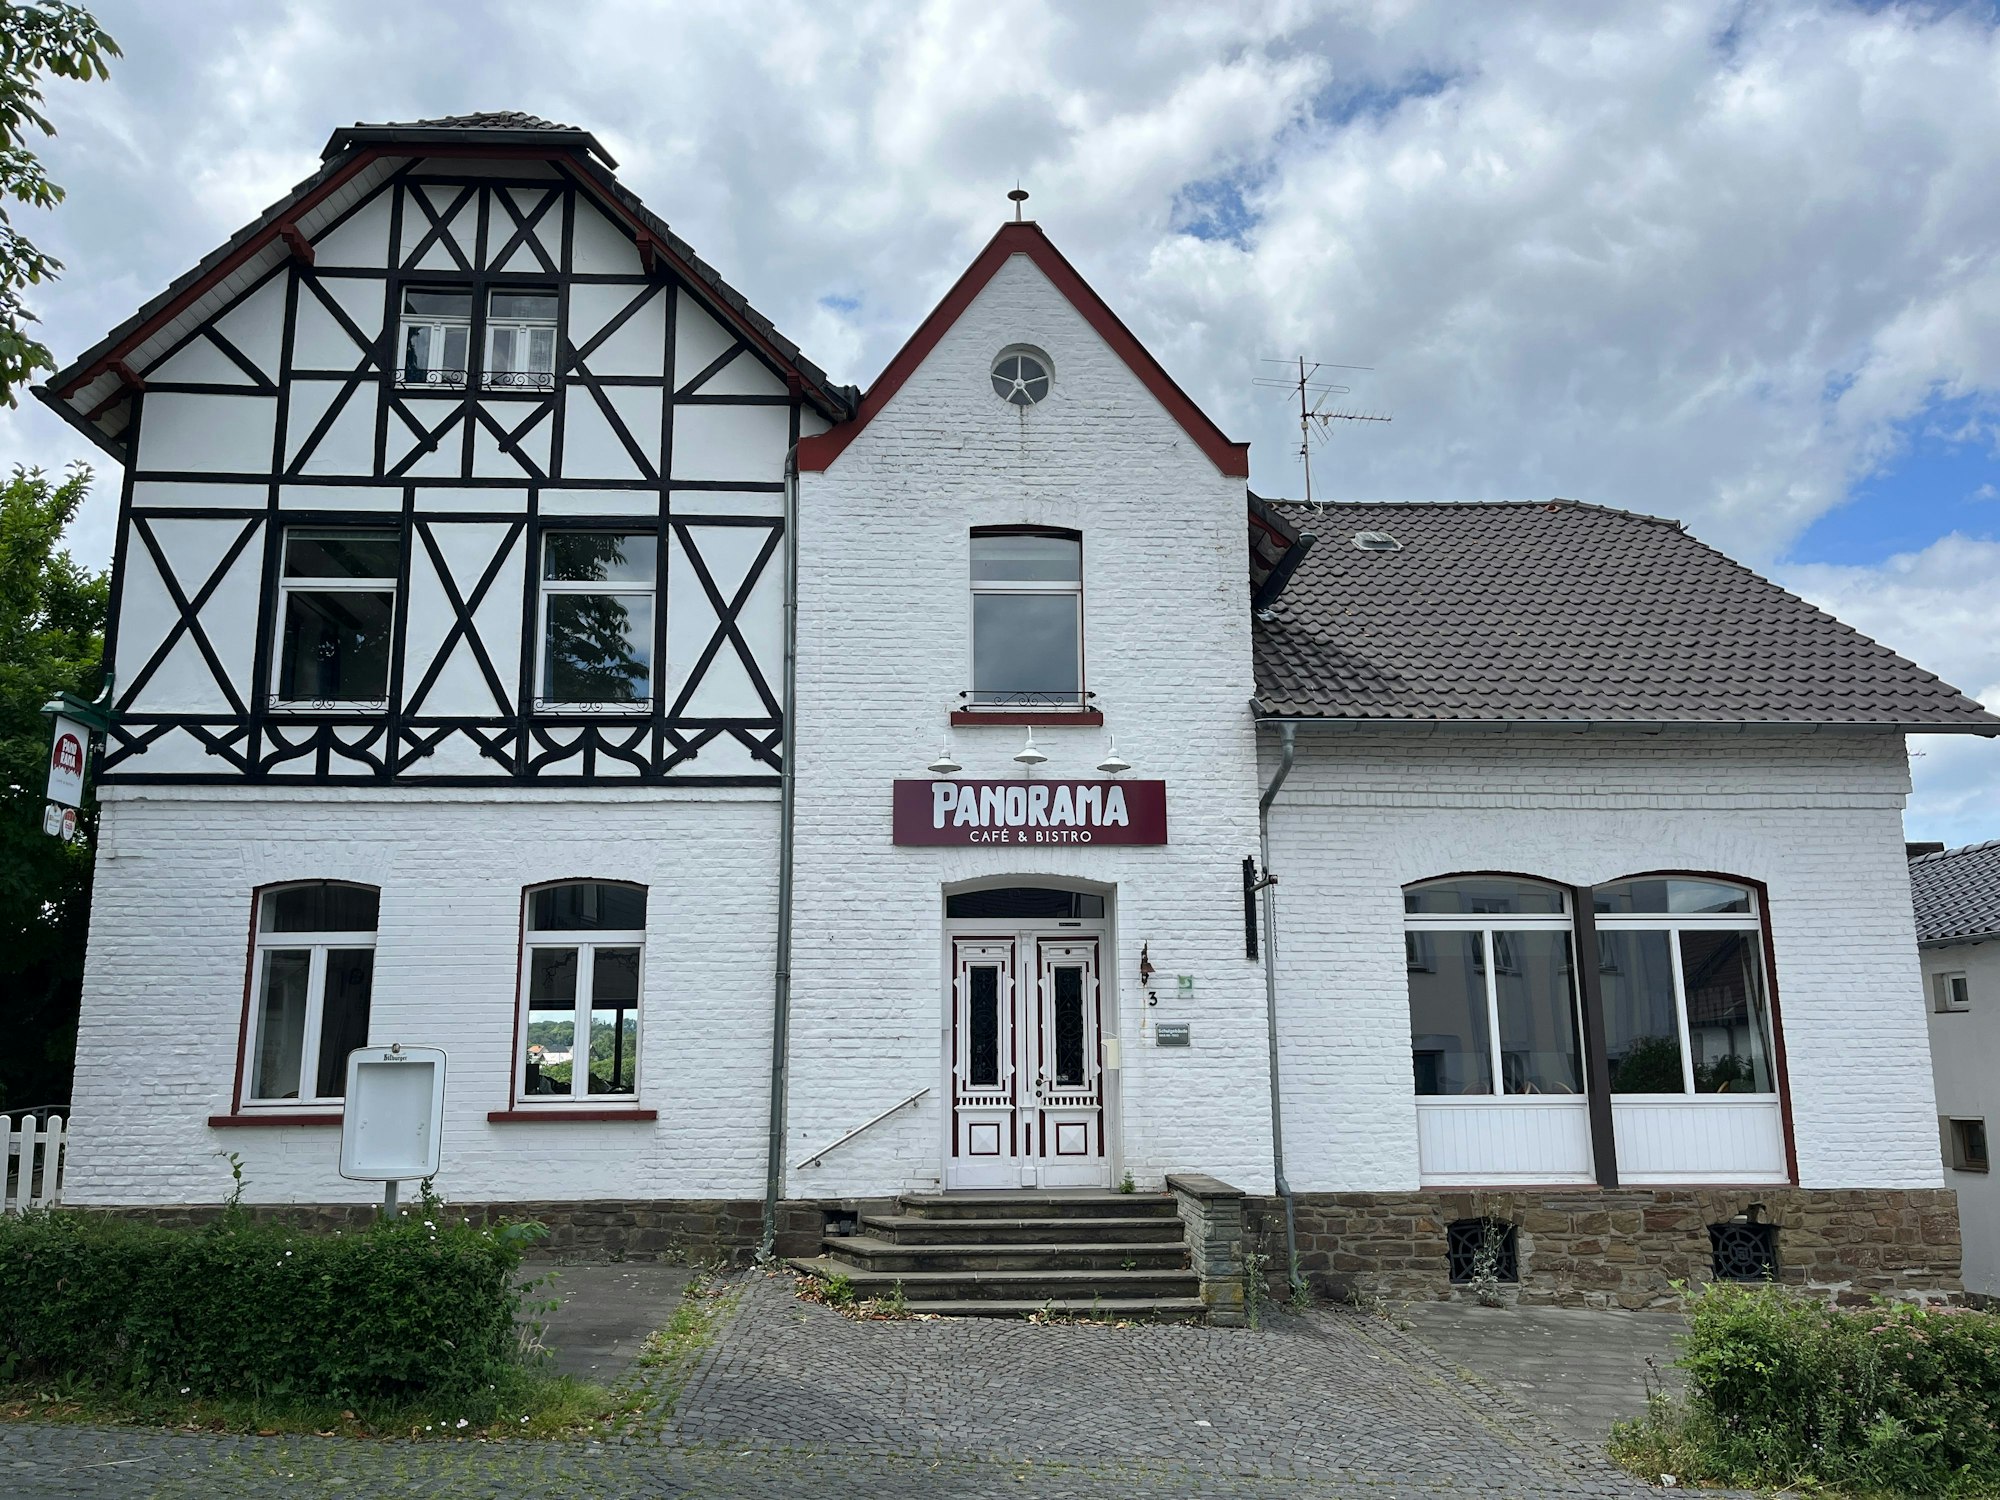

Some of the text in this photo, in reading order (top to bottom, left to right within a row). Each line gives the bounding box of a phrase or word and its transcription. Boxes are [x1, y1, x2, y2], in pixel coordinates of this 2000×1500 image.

[931, 782, 1129, 829] PANORAMA
[969, 828, 1092, 843] CAFÉ & BISTRO
[1148, 991, 1158, 1006] 3
